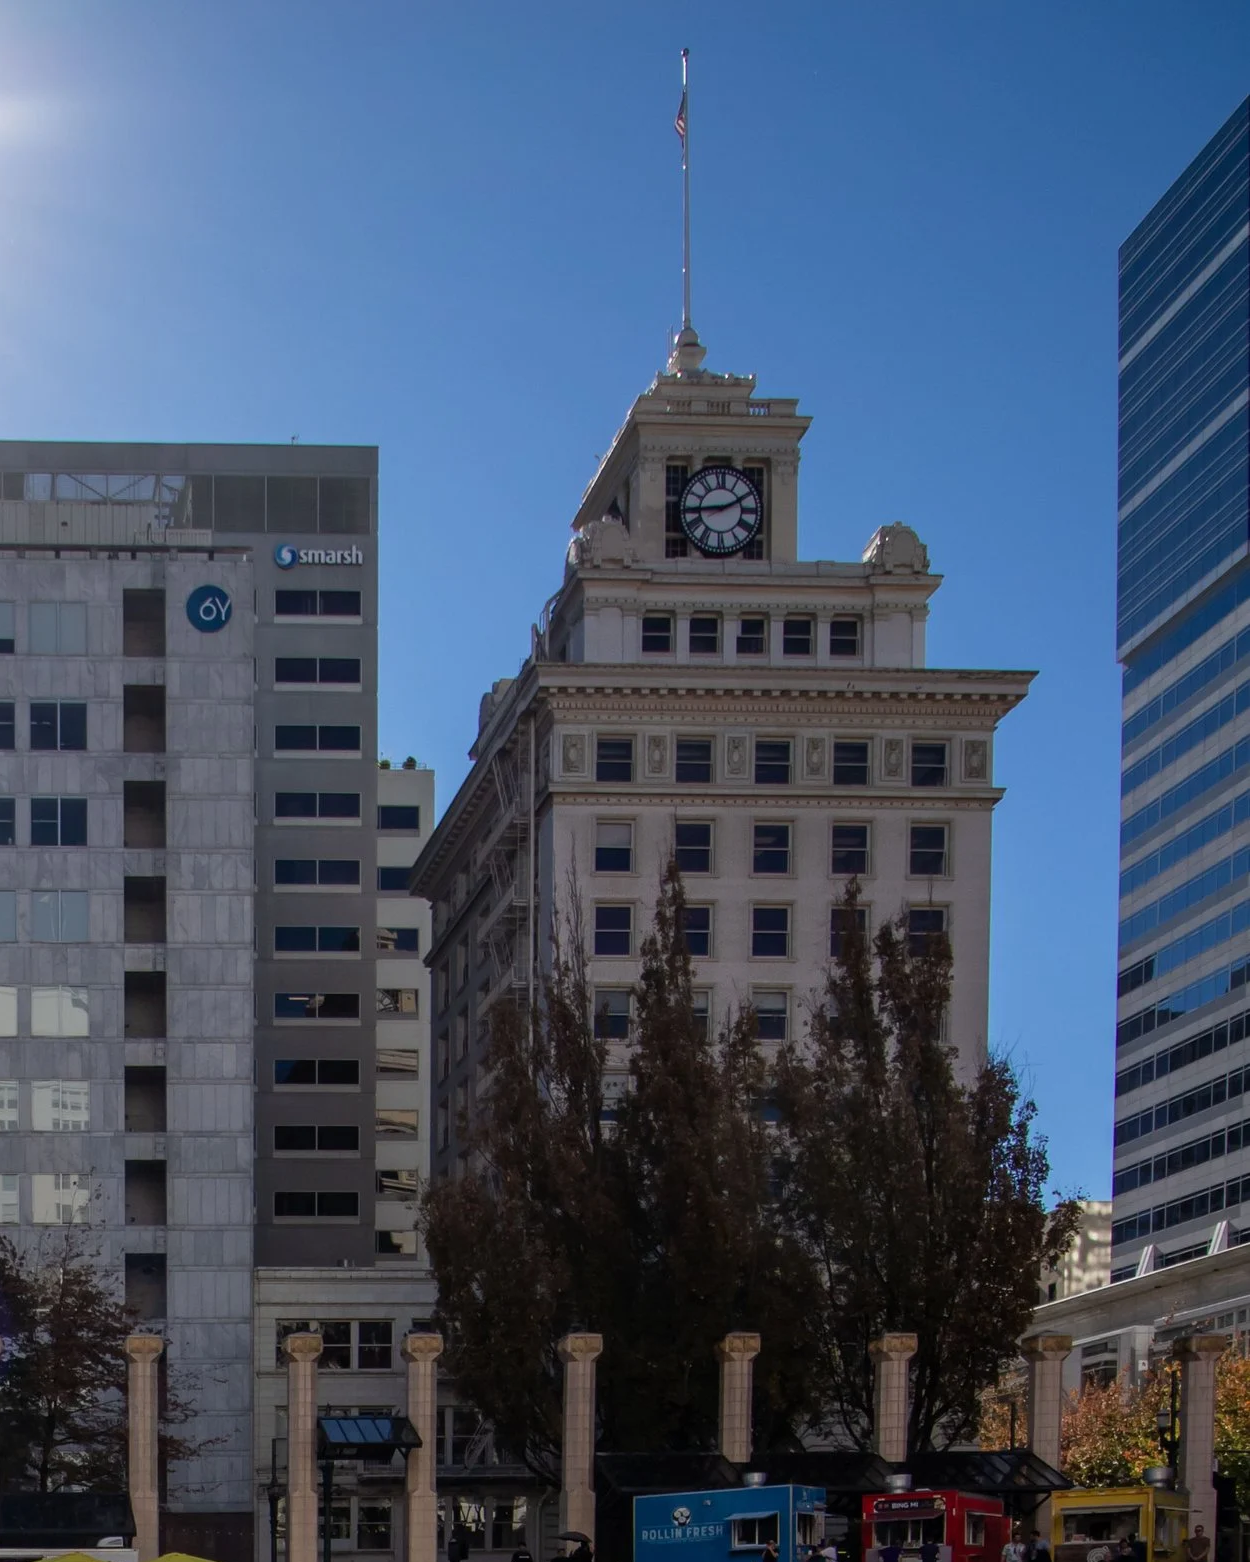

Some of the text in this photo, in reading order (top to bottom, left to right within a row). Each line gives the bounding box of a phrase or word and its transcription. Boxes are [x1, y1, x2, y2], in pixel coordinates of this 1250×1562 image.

[299, 545, 363, 565] smarsh
[642, 1527, 682, 1541] ROLLIN
[686, 1525, 724, 1539] FRESH
